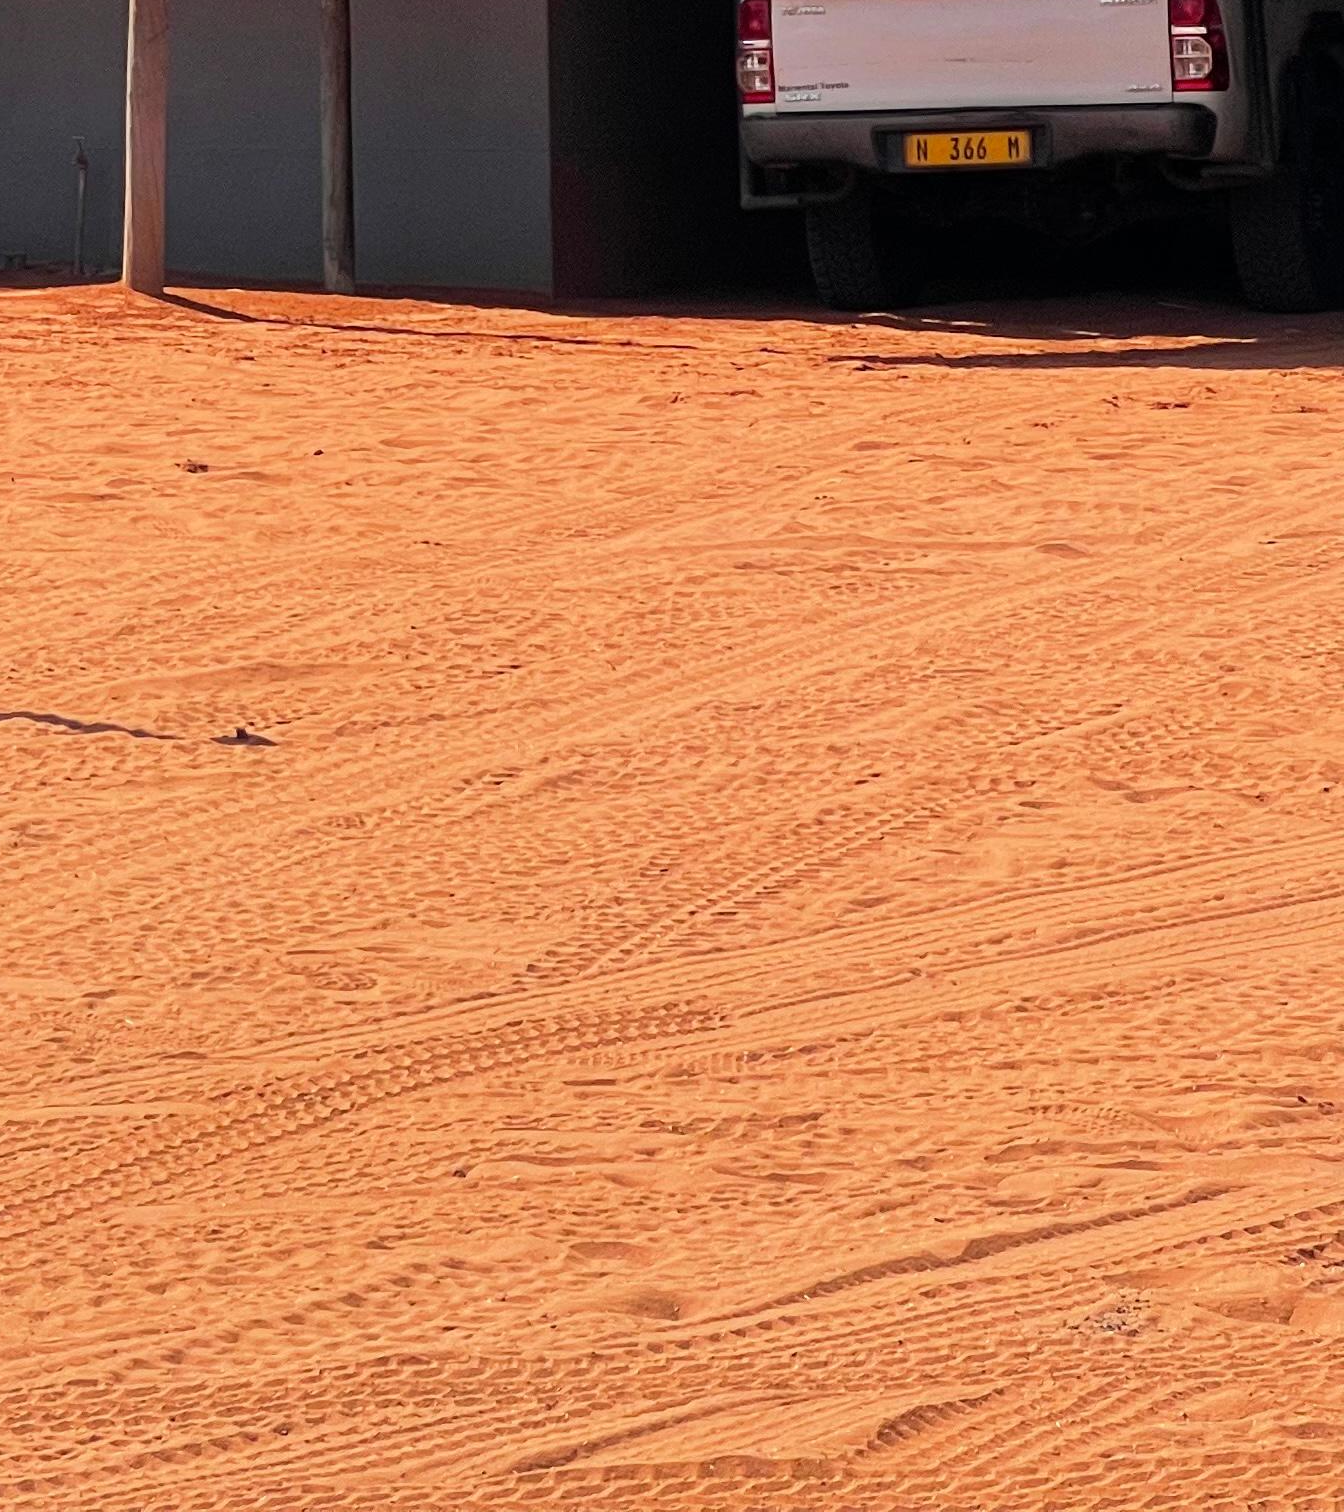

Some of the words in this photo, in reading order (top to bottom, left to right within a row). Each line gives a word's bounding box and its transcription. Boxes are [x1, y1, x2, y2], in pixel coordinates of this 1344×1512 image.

[916, 138, 929, 162] N
[949, 136, 988, 161] 366
[1007, 135, 1020, 159] M
